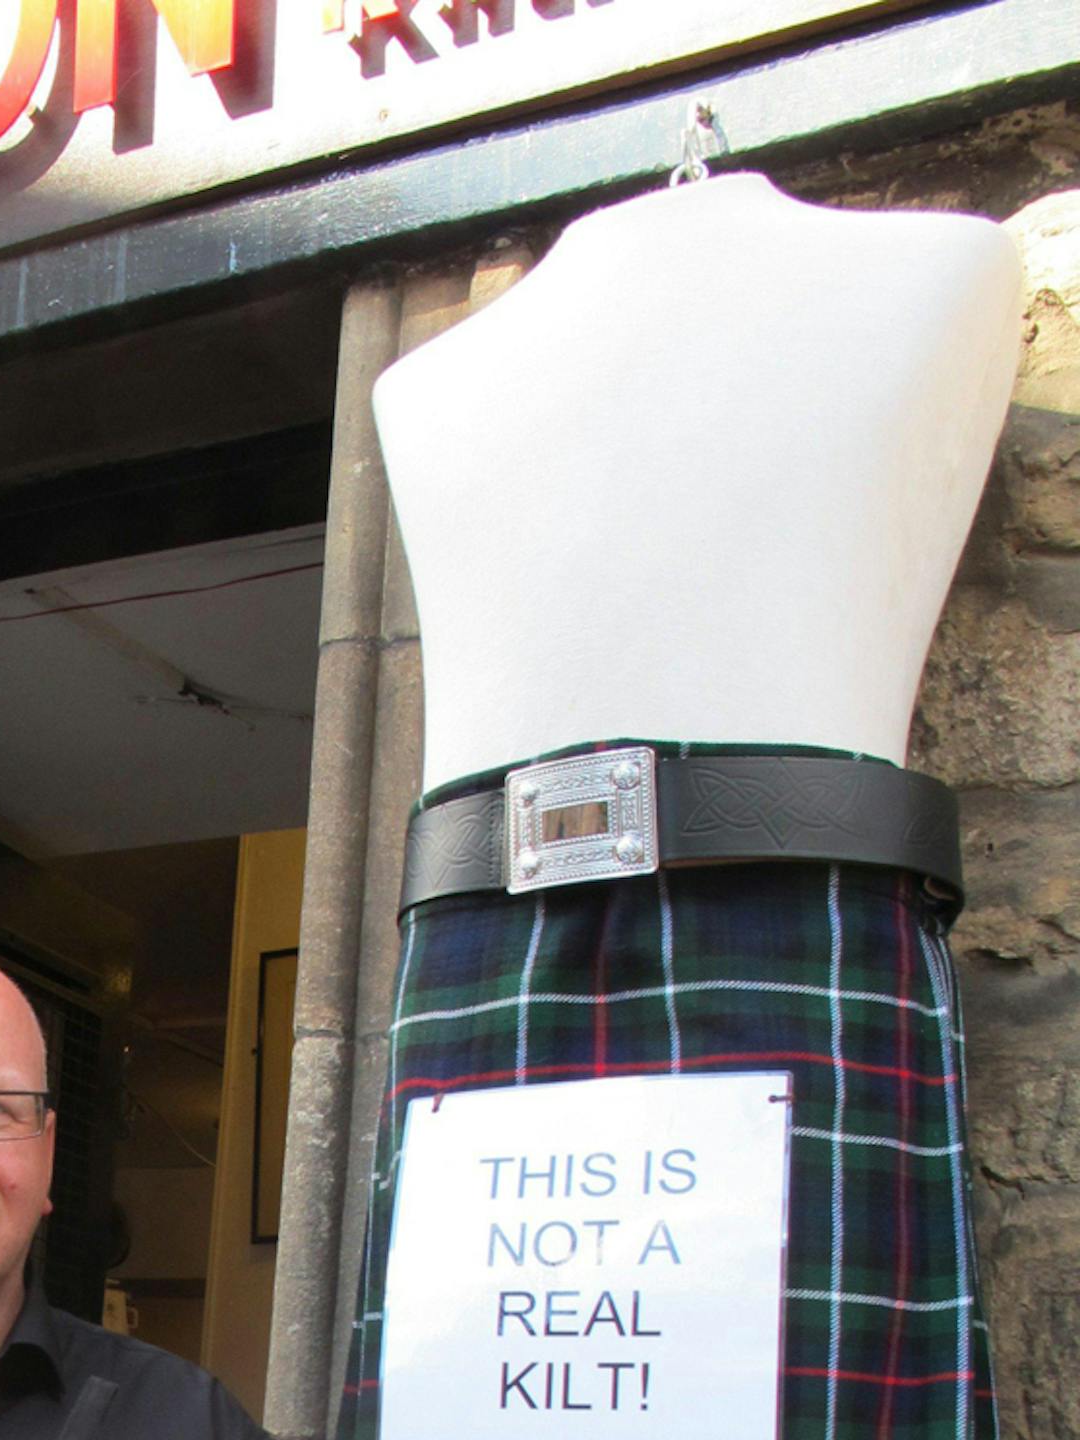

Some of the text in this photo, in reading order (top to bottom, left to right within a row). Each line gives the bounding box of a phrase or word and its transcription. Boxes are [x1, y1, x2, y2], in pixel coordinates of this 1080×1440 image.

[479, 1148, 697, 1200] THIS IS
[487, 1220, 681, 1267] NOT A
[497, 1290, 662, 1337] REAL
[499, 1361, 650, 1411] KILT!
